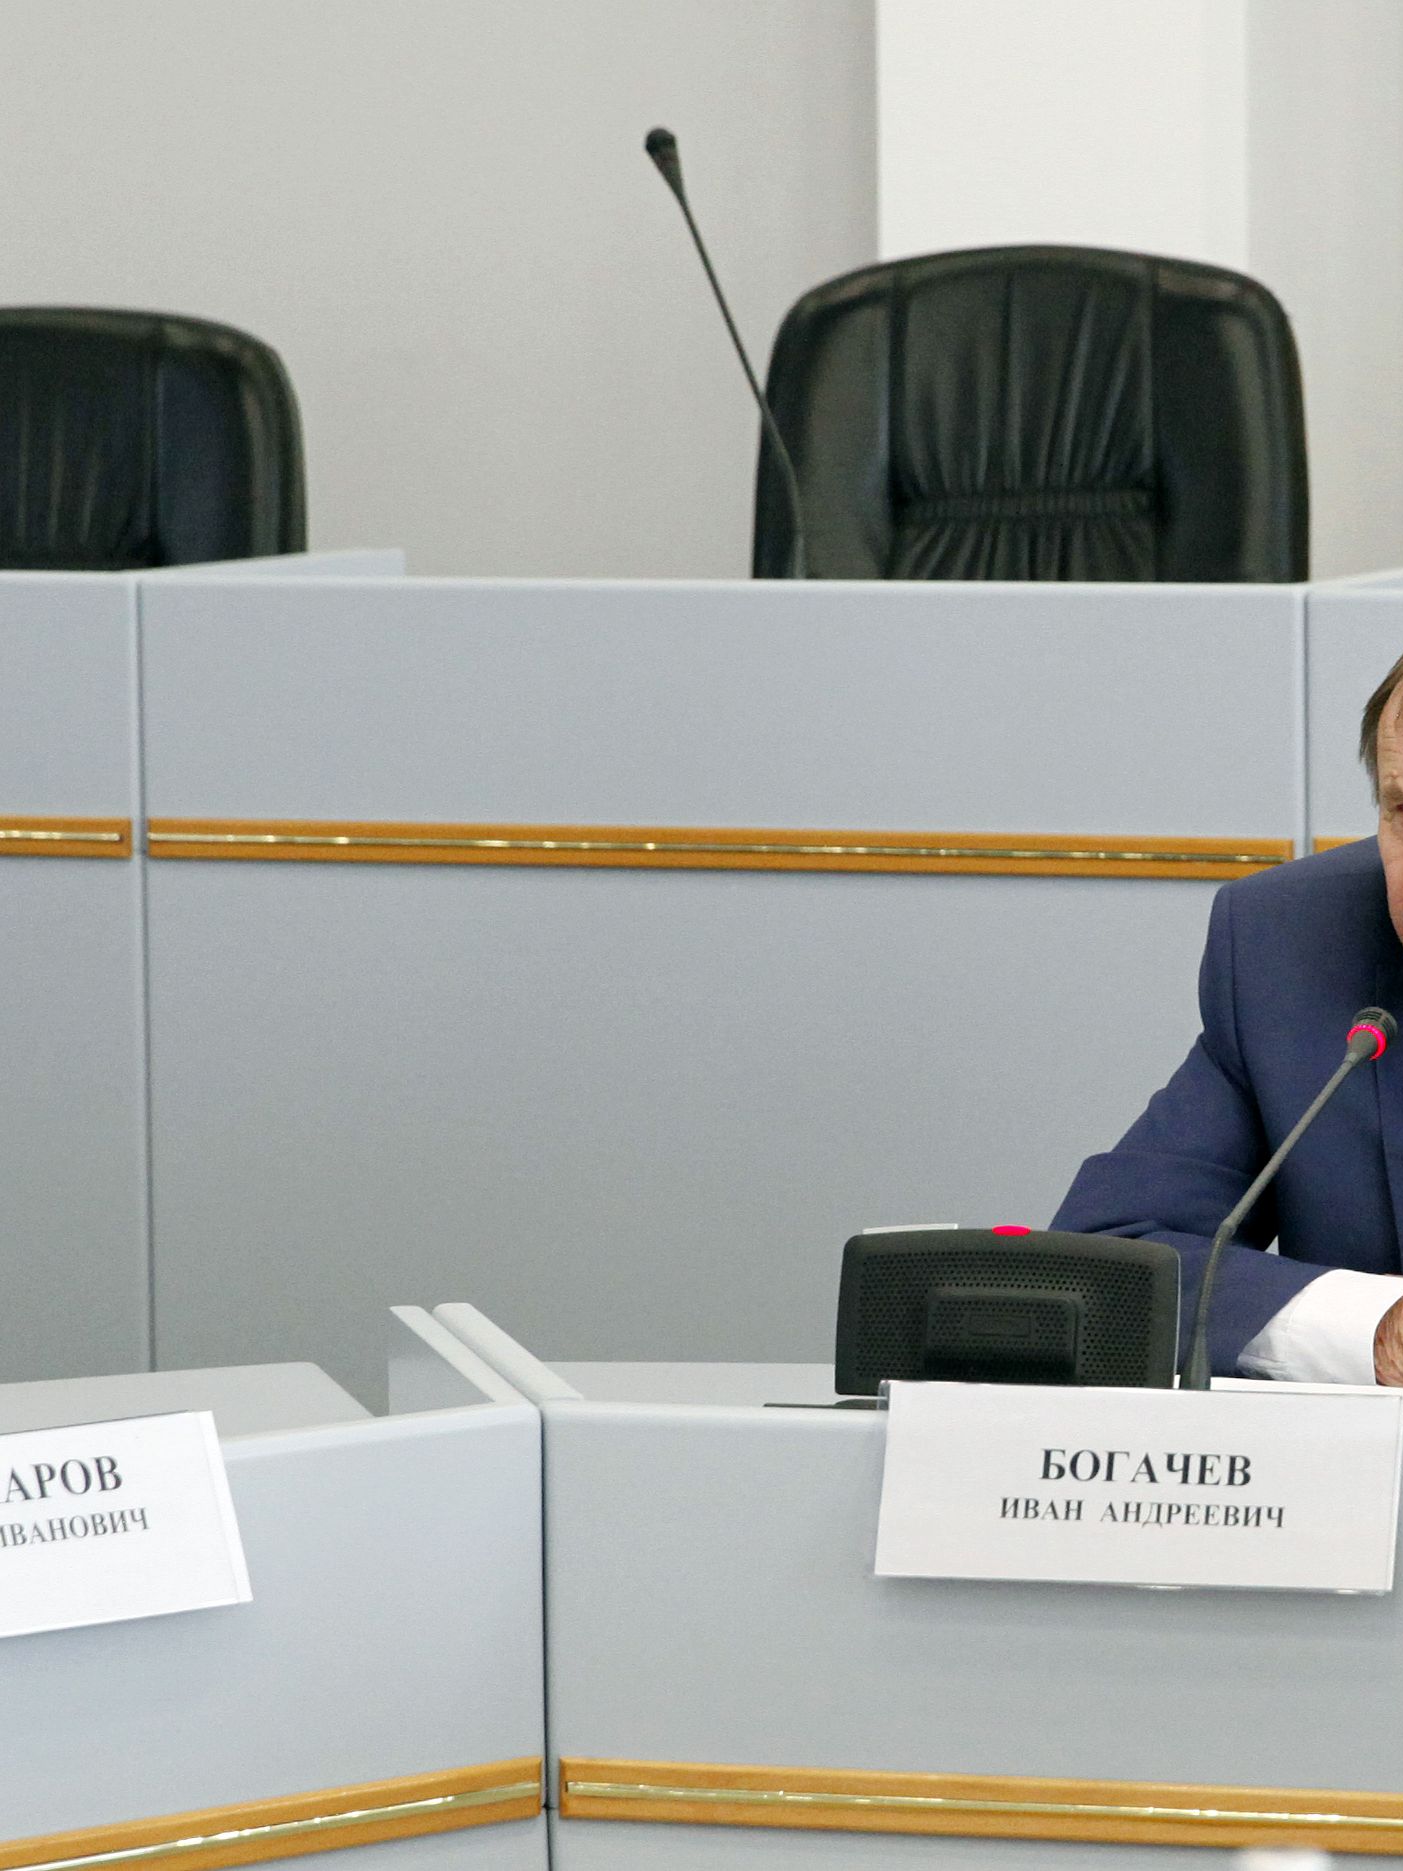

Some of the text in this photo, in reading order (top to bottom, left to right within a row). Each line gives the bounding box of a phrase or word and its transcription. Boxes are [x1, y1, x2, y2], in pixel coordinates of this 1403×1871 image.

[1, 1455, 123, 1503] АРОВ
[1038, 1448, 1252, 1486] БОГАЧЕВ
[999, 1497, 1286, 1528] ИВАН АНДРЕЕВИЧ
